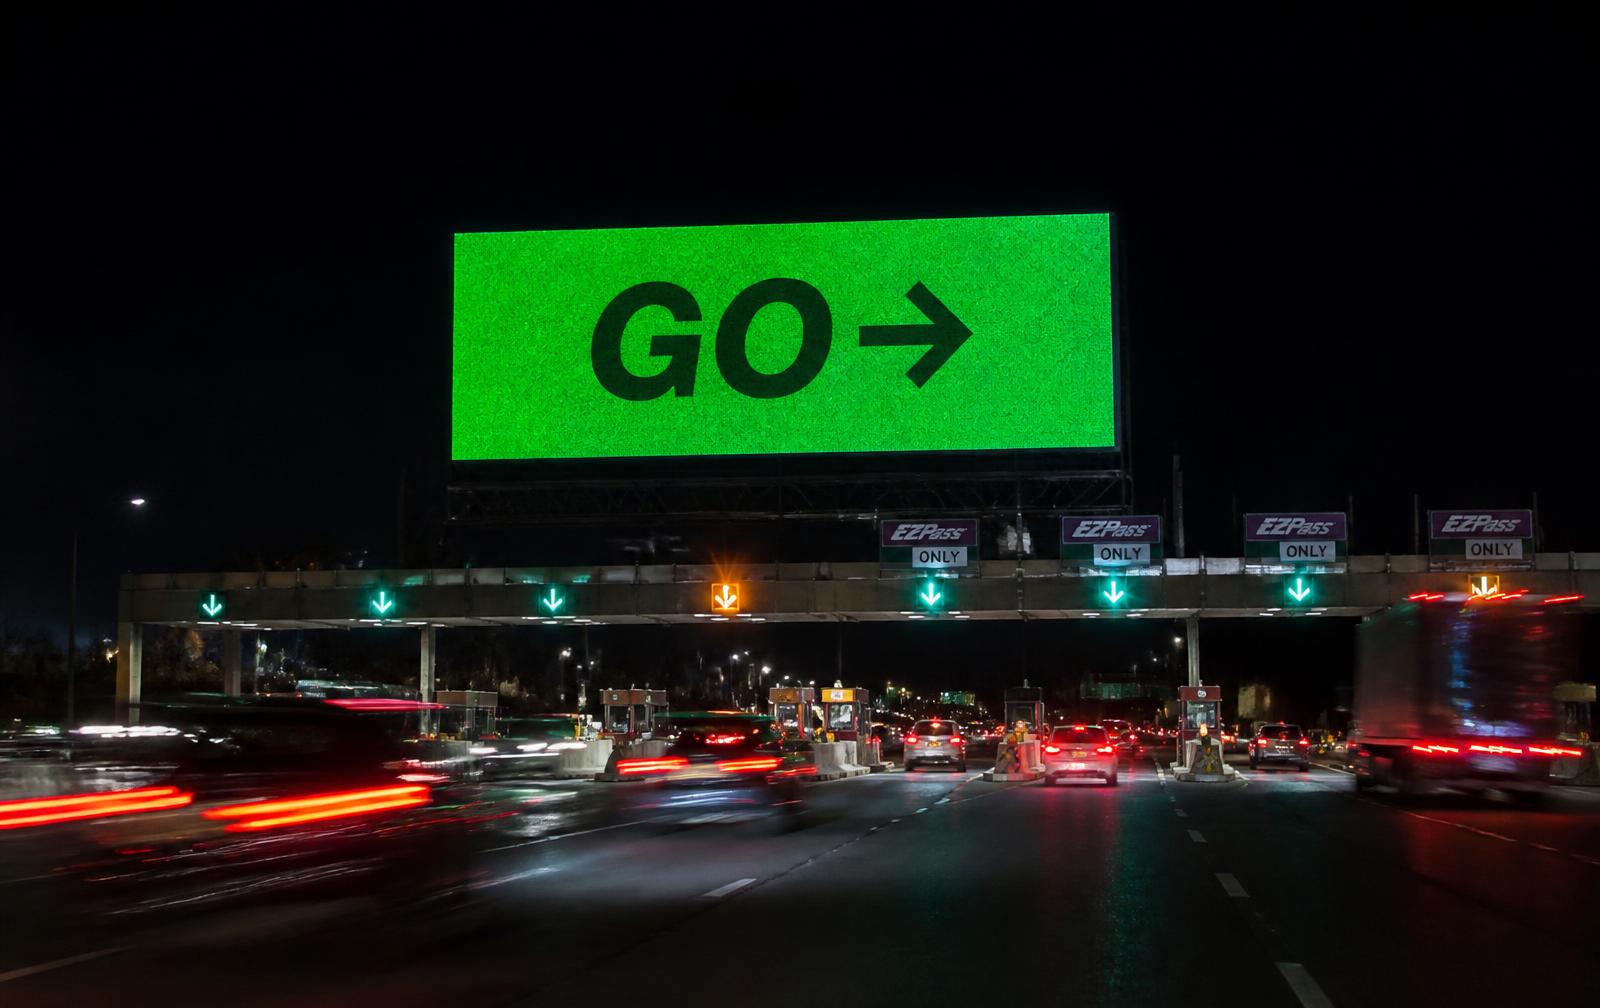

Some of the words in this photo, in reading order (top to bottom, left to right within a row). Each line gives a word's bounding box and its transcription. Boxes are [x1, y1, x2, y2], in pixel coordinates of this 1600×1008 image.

[591, 278, 832, 401] GO
[1100, 548, 1142, 560] ONLY
[1286, 545, 1327, 558] ONLY
[1471, 543, 1513, 556] ONLY
[919, 551, 960, 563] ONLY
